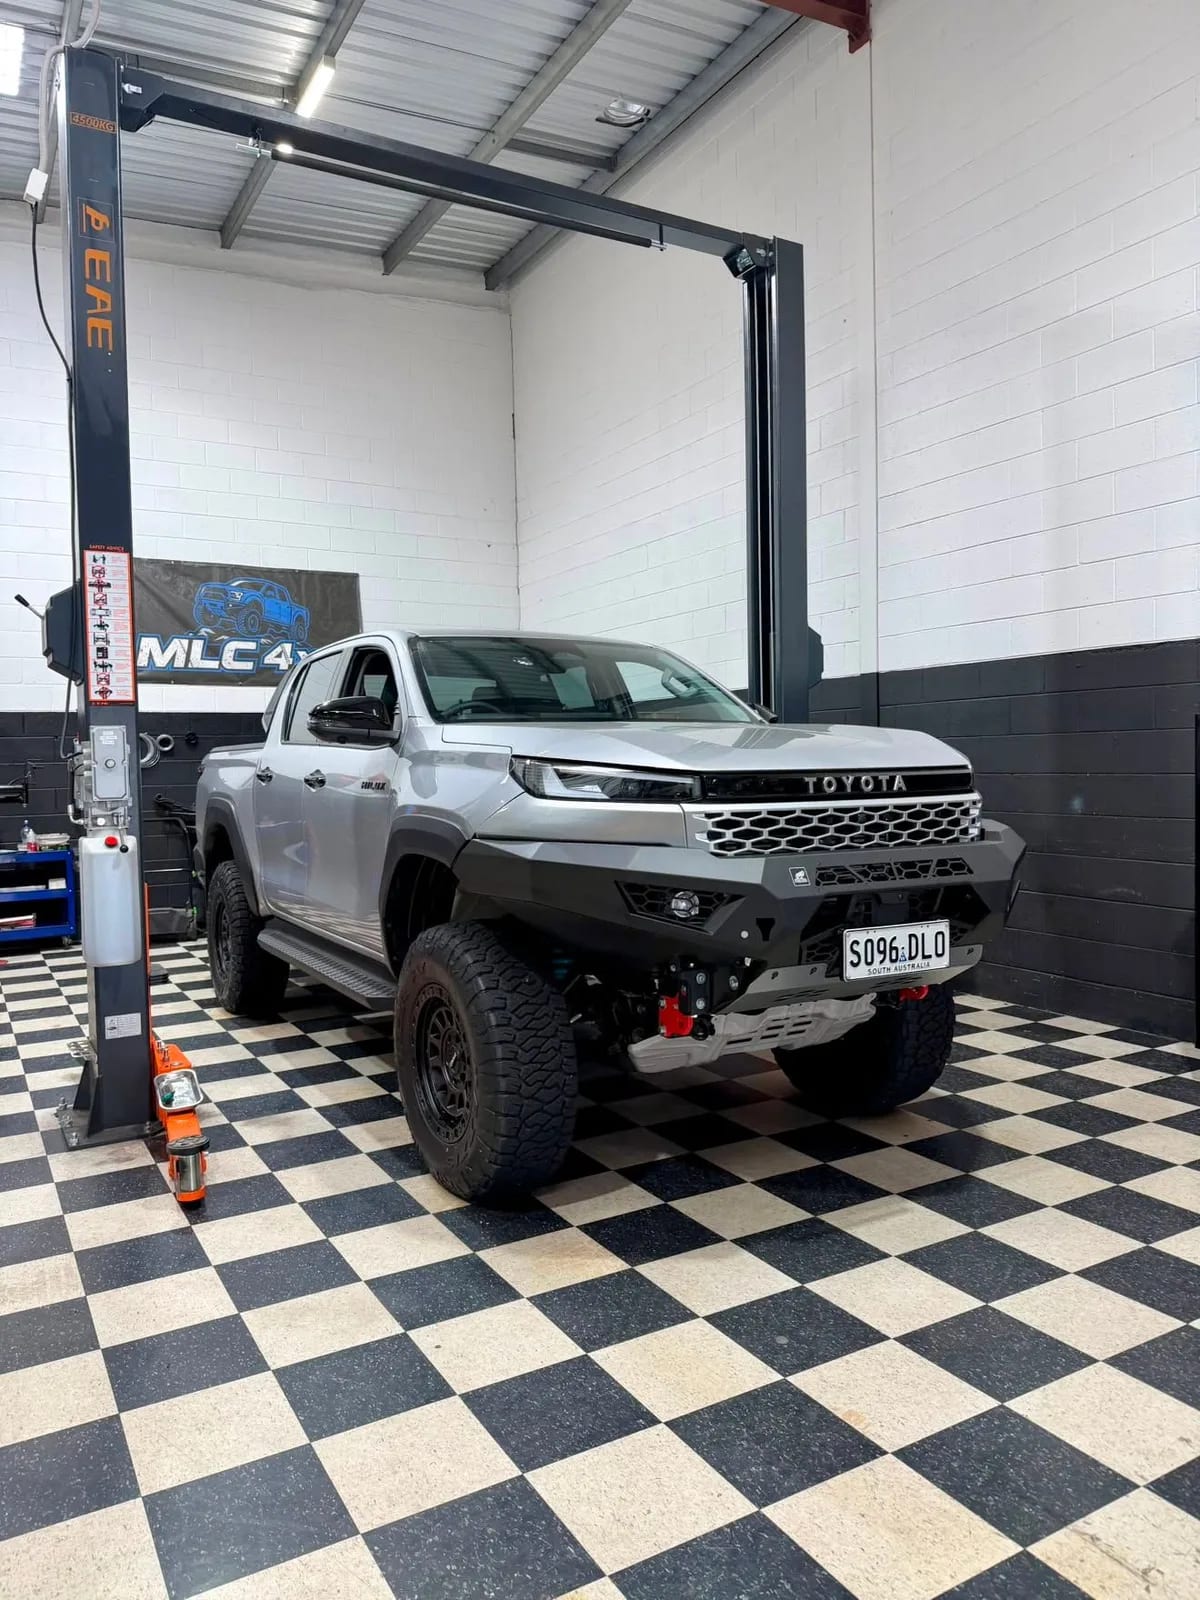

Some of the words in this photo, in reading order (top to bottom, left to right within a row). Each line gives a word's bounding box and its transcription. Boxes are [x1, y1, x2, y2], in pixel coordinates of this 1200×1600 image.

[137, 637, 257, 671] MLC
[804, 775, 907, 794] TOYOTA
[868, 967, 891, 976] SOUTH
[894, 962, 930, 973] AUSTRALIA
